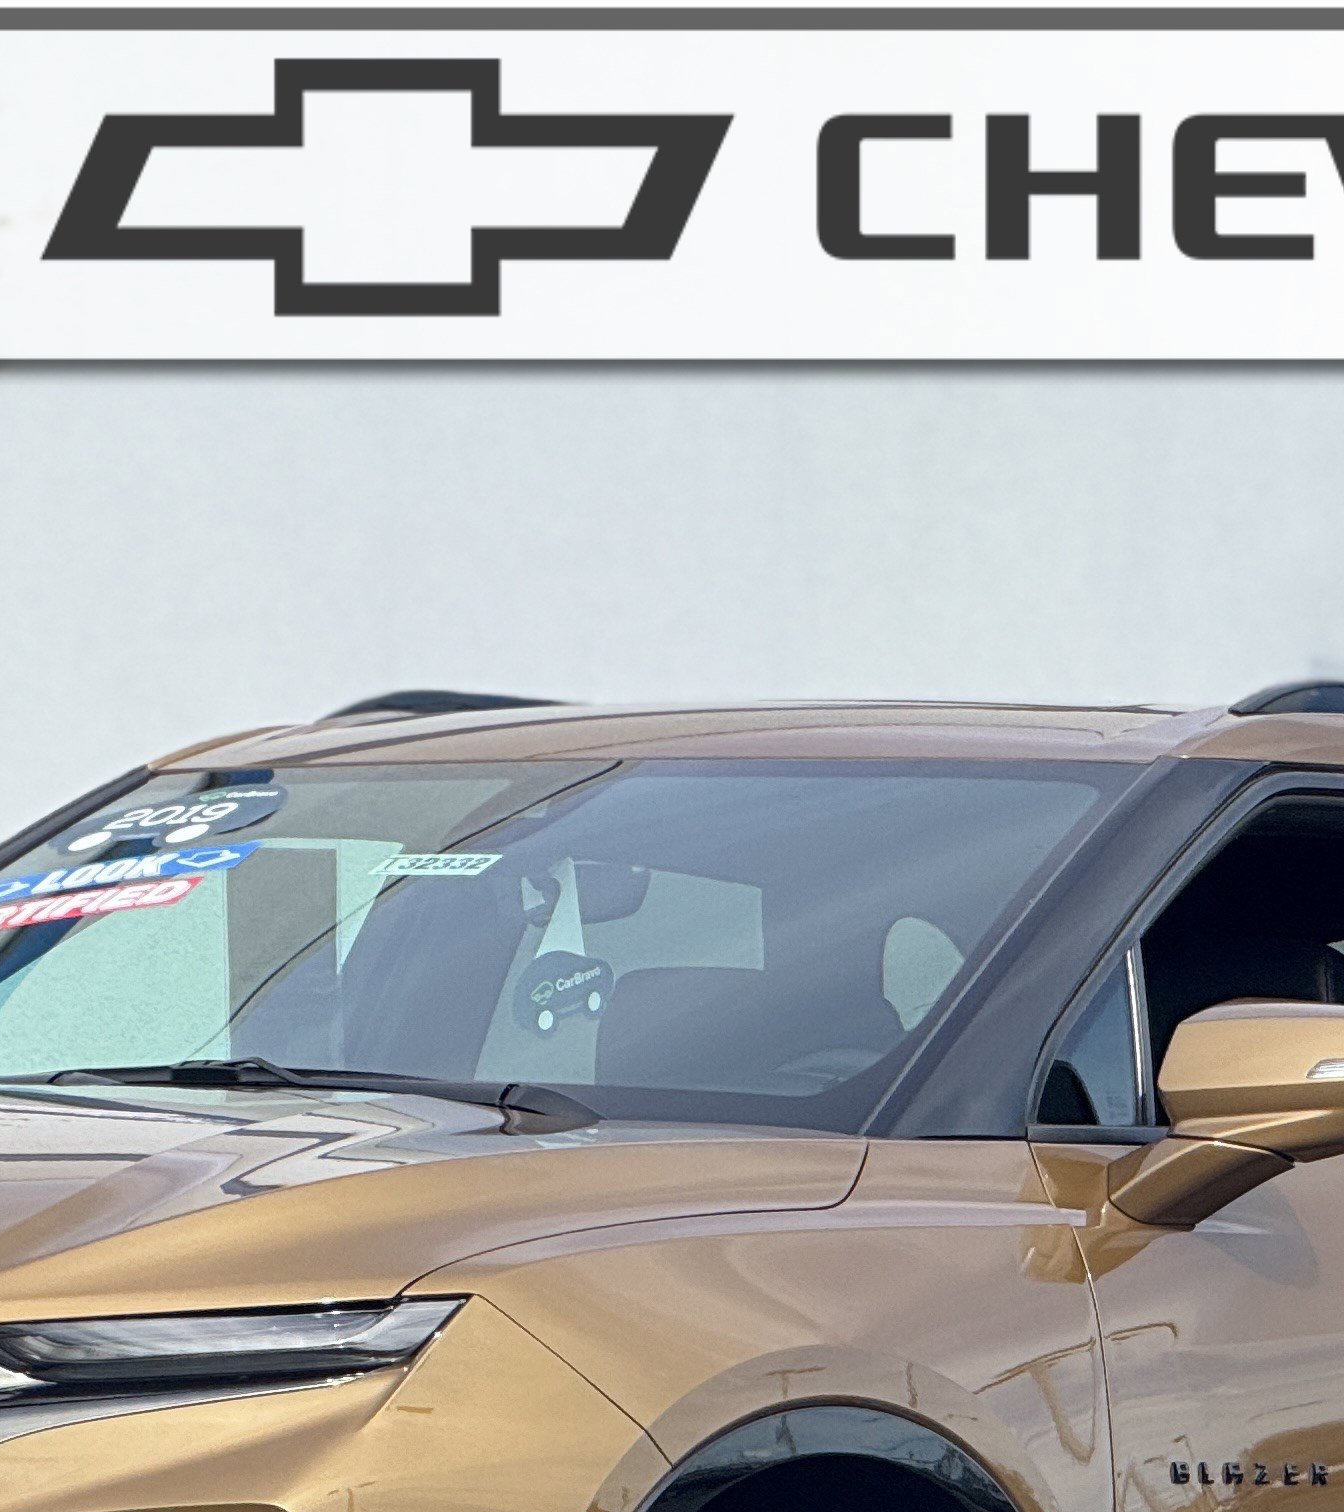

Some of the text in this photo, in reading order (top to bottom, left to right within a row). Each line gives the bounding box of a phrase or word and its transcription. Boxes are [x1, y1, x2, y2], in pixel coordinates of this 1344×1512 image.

[102, 801, 240, 832] 2019
[30, 851, 182, 895] LOOK
[555, 966, 602, 992] CarBravo
[1169, 1461, 1329, 1487] BLAZER
